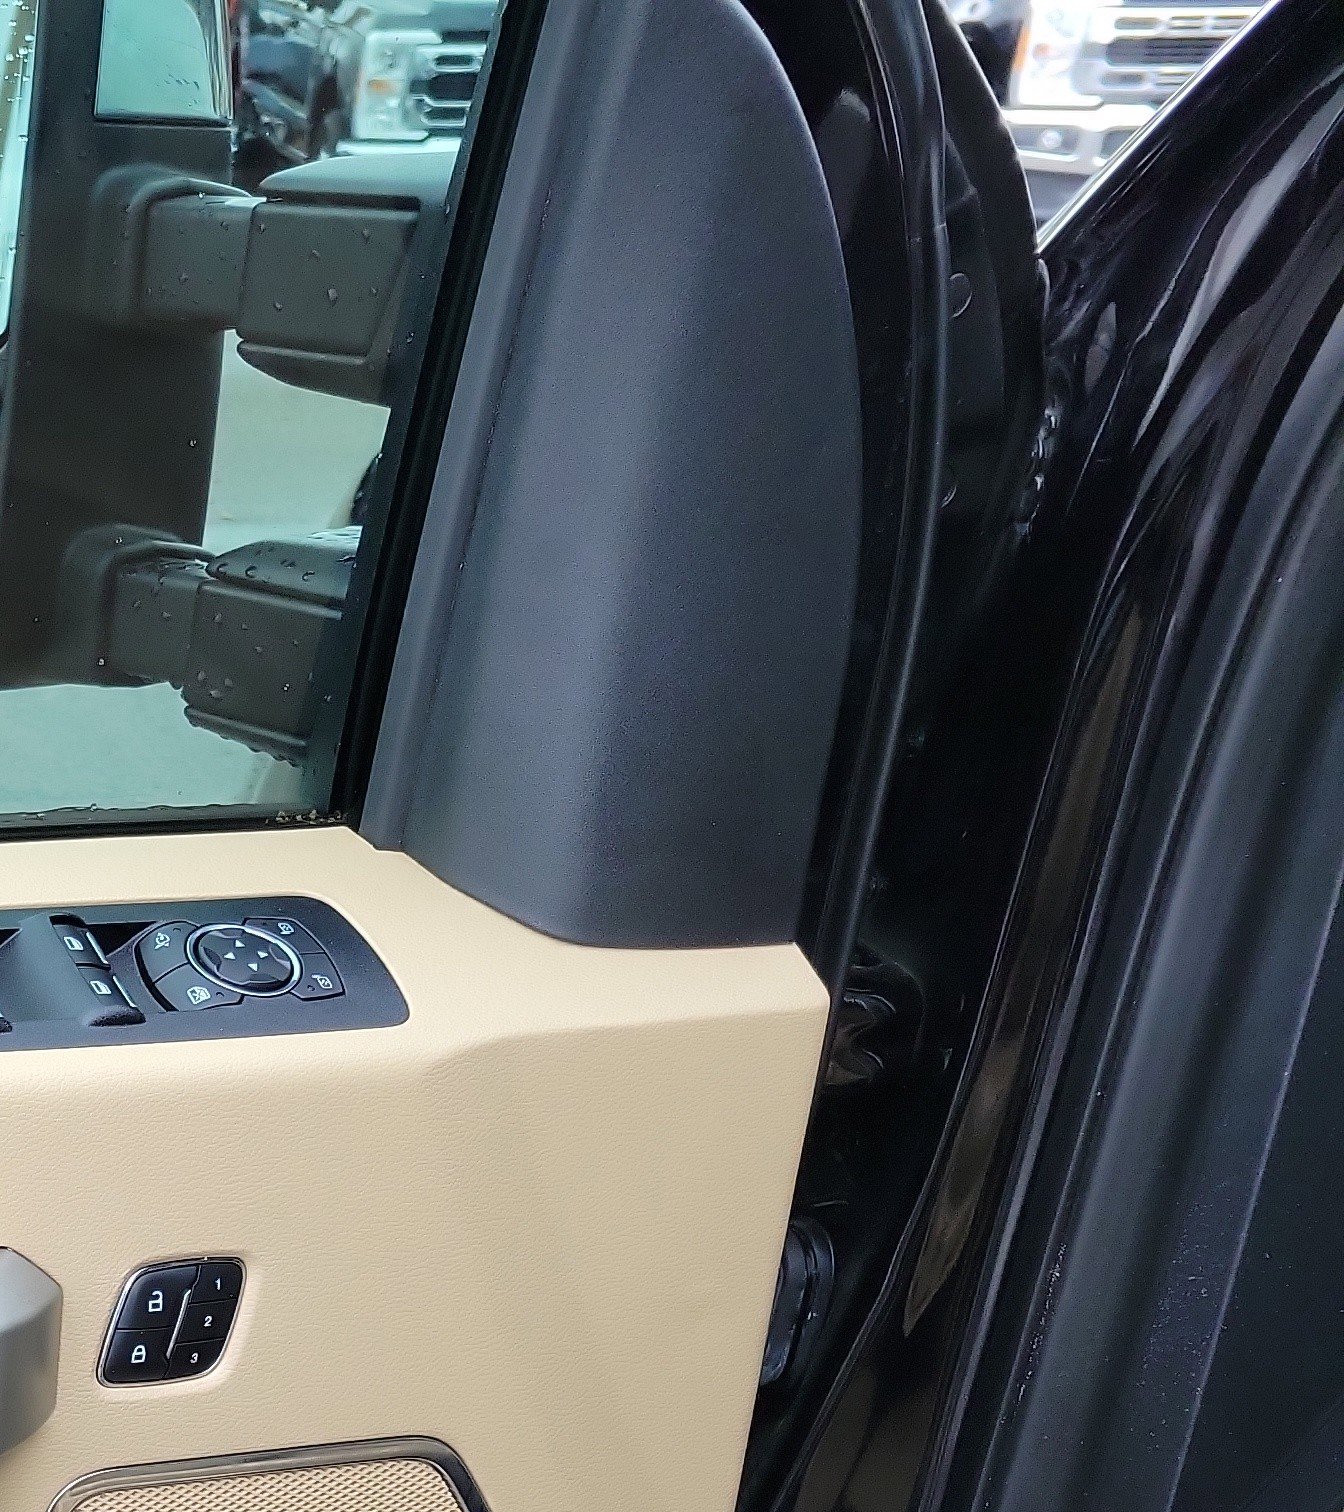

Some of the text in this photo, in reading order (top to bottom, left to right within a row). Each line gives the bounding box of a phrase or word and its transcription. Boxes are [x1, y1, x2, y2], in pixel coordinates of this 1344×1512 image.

[214, 1277, 222, 1291] 1
[203, 1315, 213, 1327] 2
[189, 1352, 199, 1364] 3
